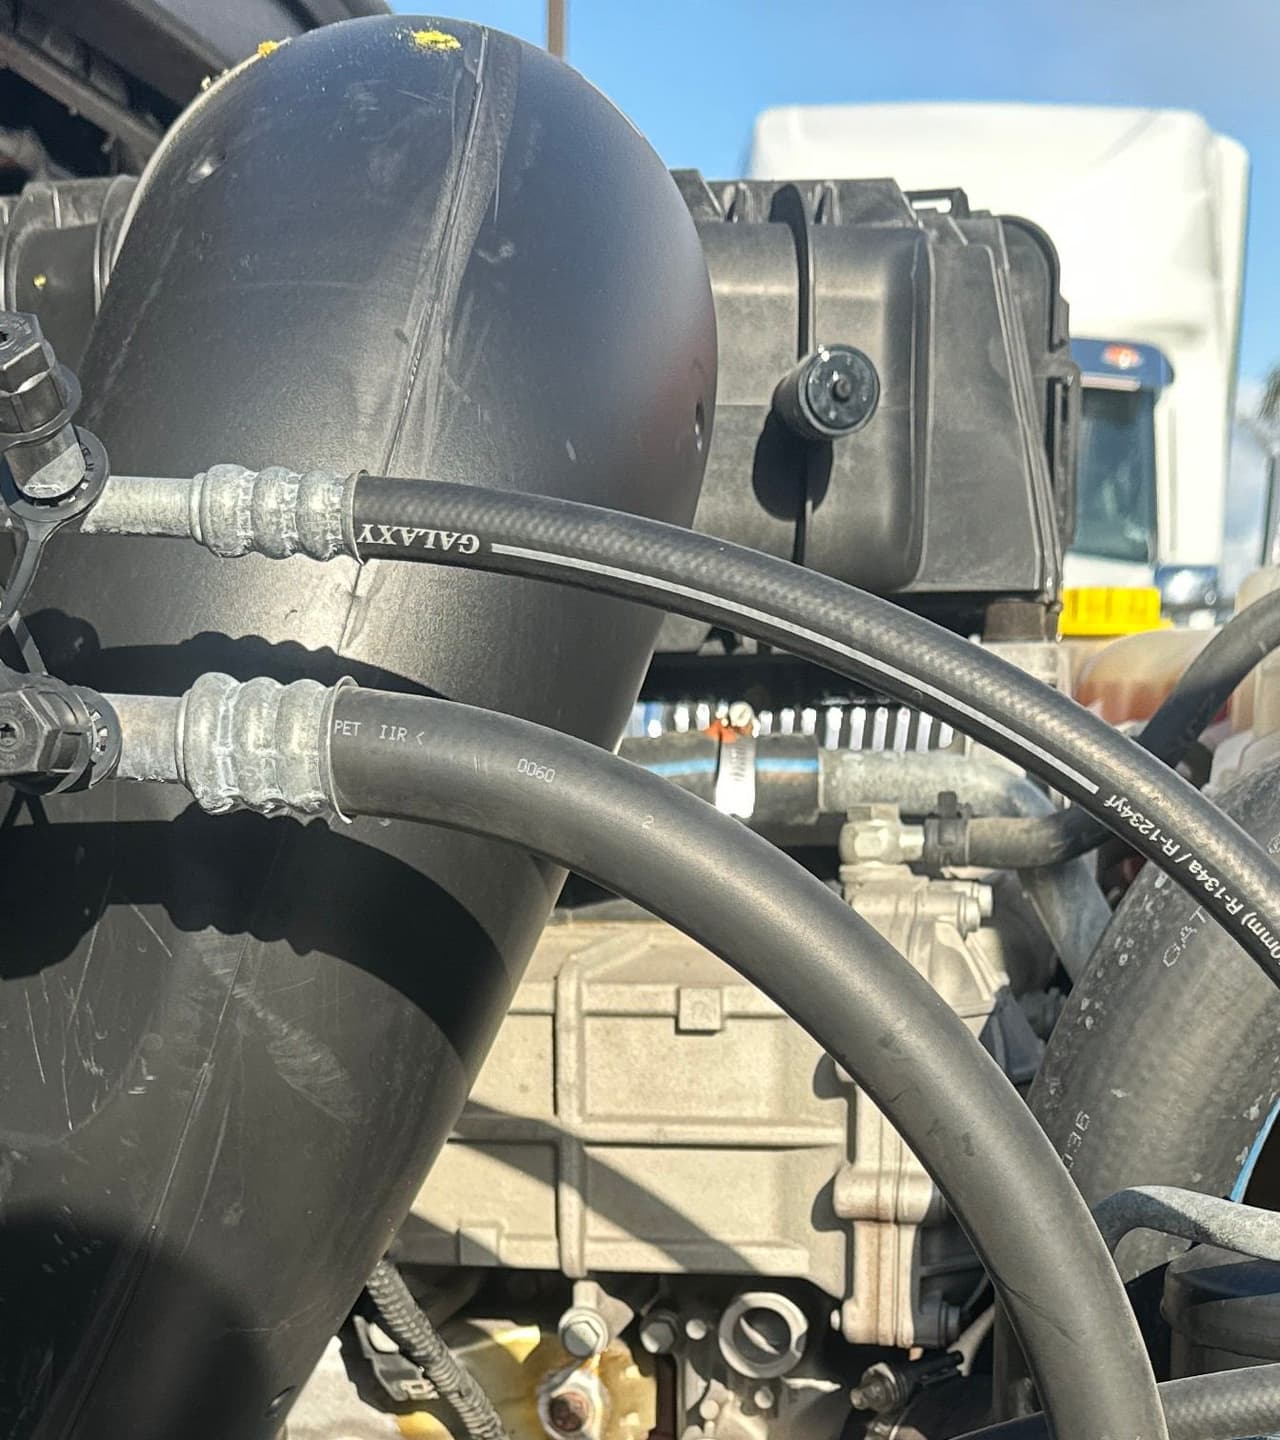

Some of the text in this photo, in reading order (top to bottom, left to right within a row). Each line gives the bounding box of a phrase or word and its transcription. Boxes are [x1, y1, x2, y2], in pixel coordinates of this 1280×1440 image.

[356, 523, 480, 555] GALAXY
[333, 718, 362, 737] PET
[516, 757, 557, 783] 0060
[1103, 794, 1182, 858] R-1234yf
[1188, 858, 1245, 916] R-134a
